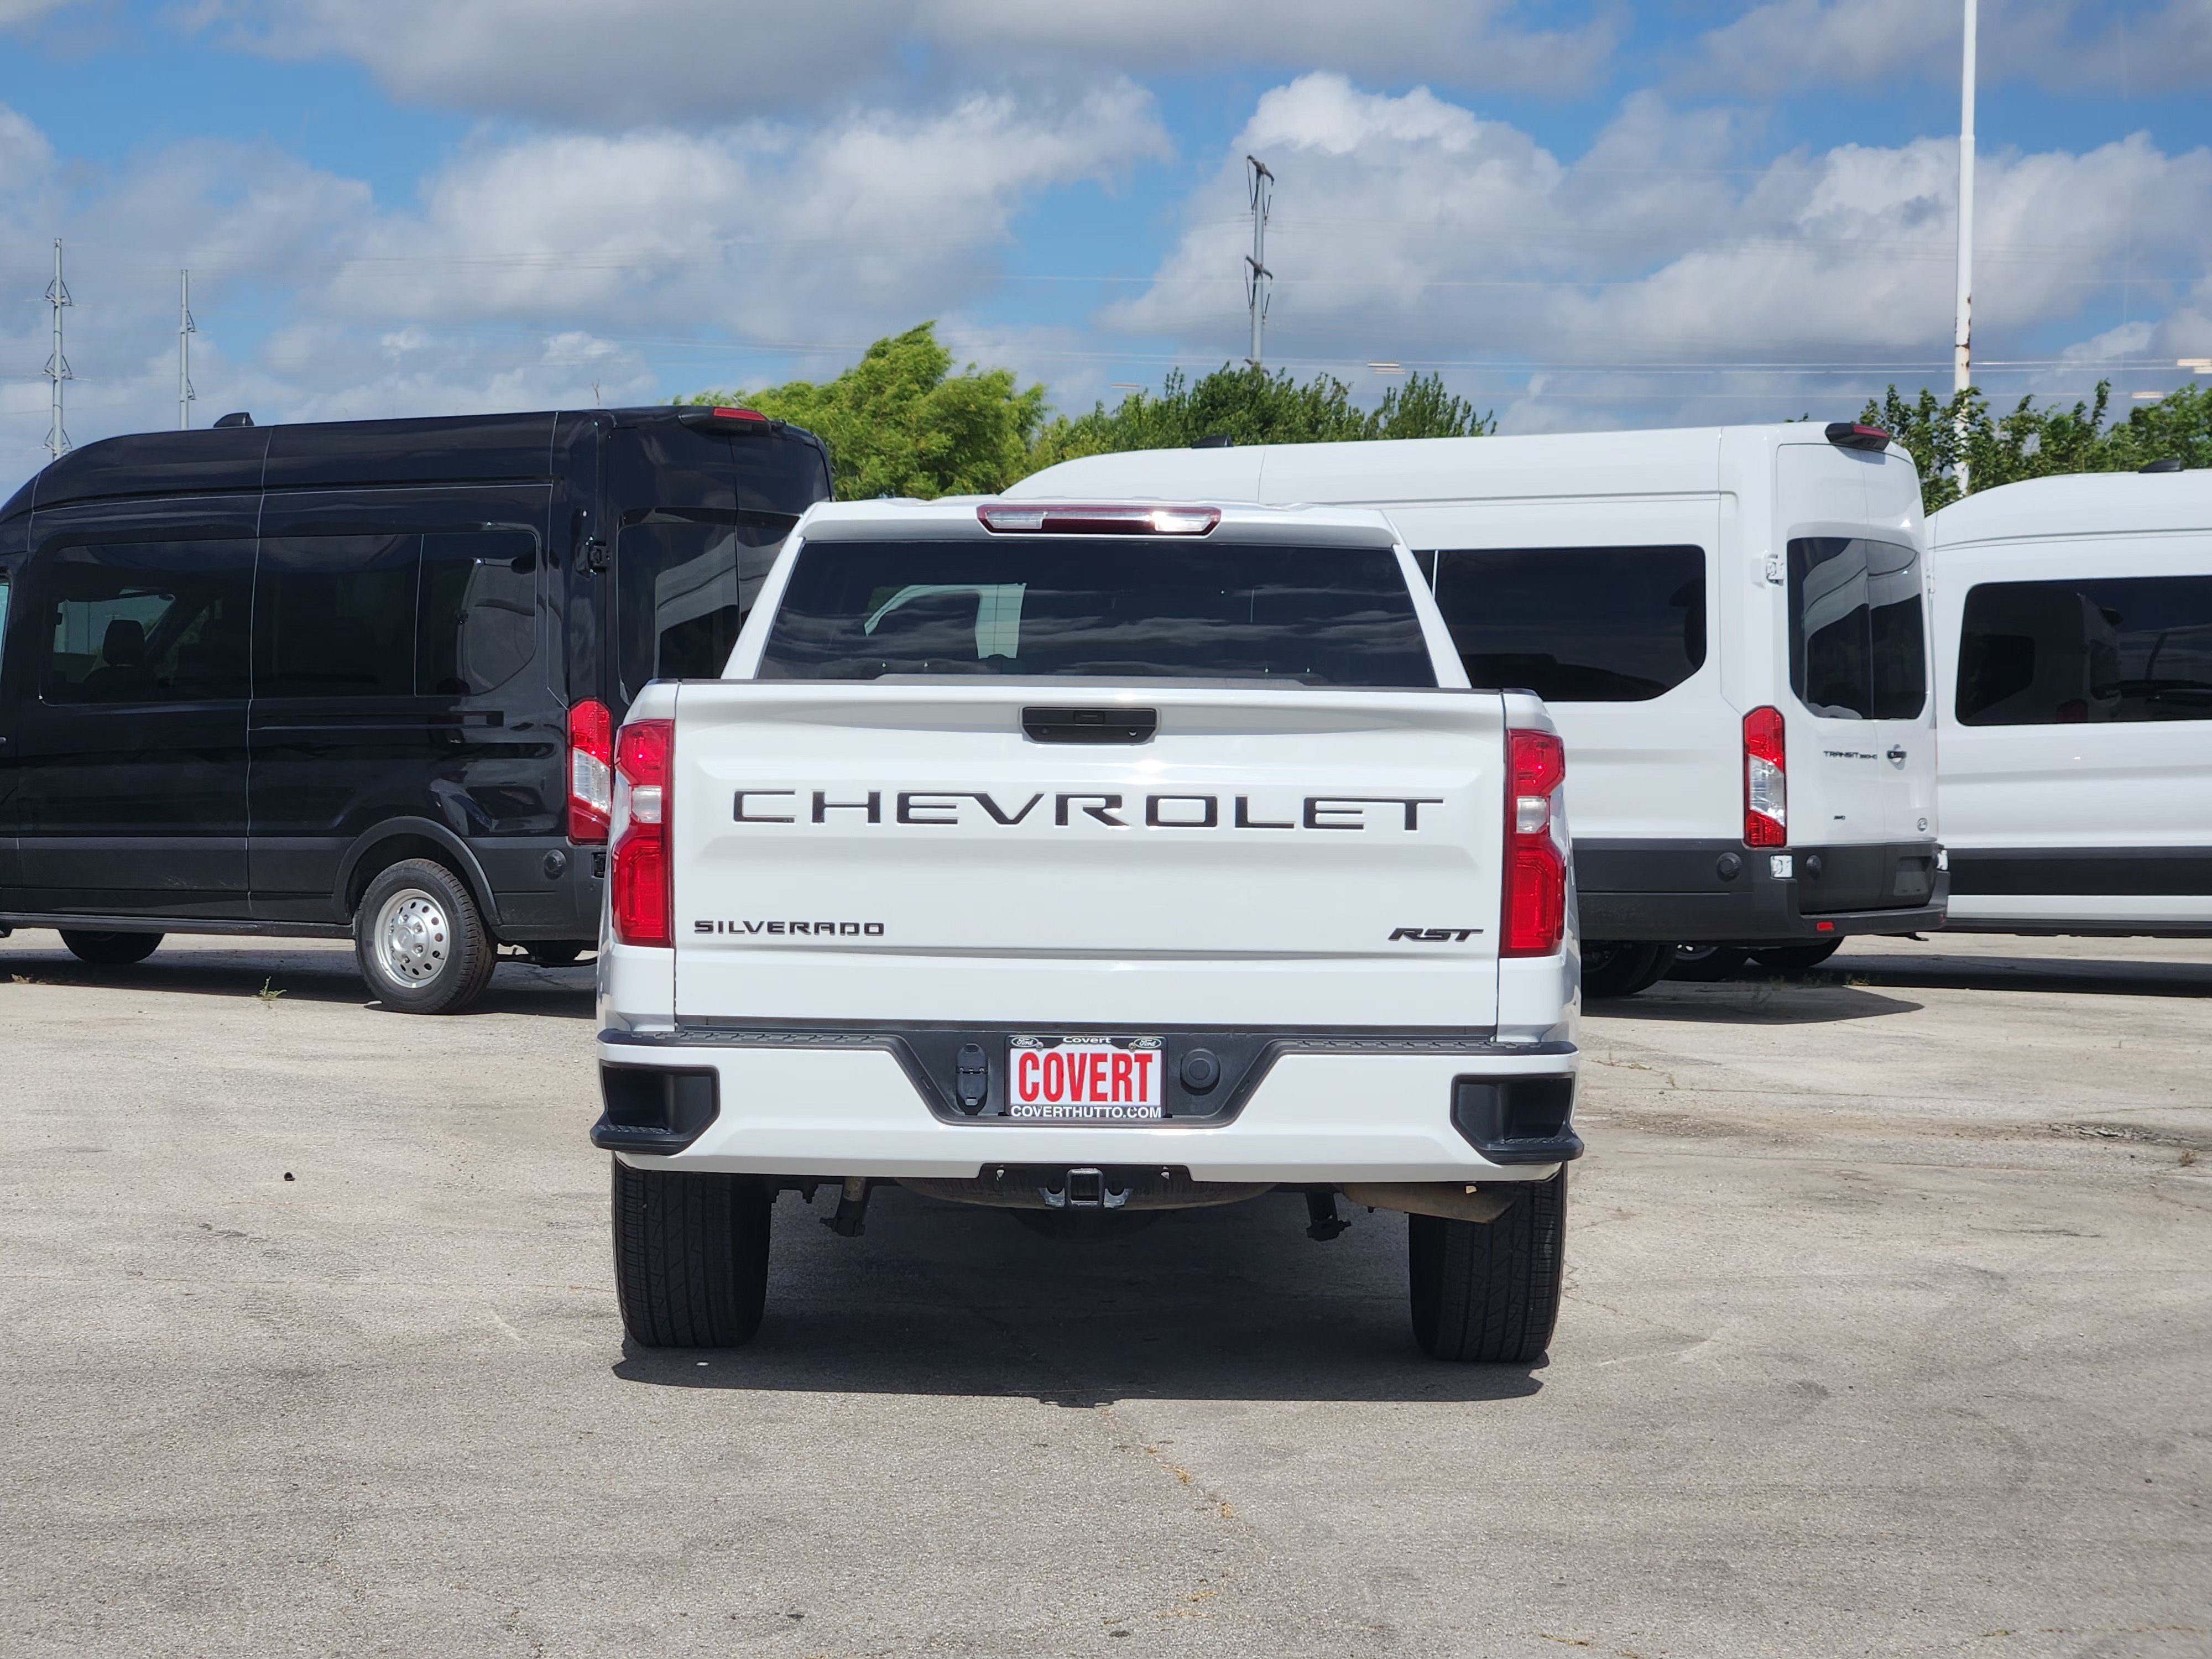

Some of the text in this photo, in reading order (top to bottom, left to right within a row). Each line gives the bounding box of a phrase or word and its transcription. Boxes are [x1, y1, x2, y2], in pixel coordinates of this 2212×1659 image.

[734, 790, 1444, 831] CHEVROLET
[694, 920, 885, 936] SILVERADO
[1388, 927, 1484, 942] RST
[1019, 1051, 1153, 1102] COVERT
[1011, 1105, 1161, 1118] COVERTHUTTO.COM
